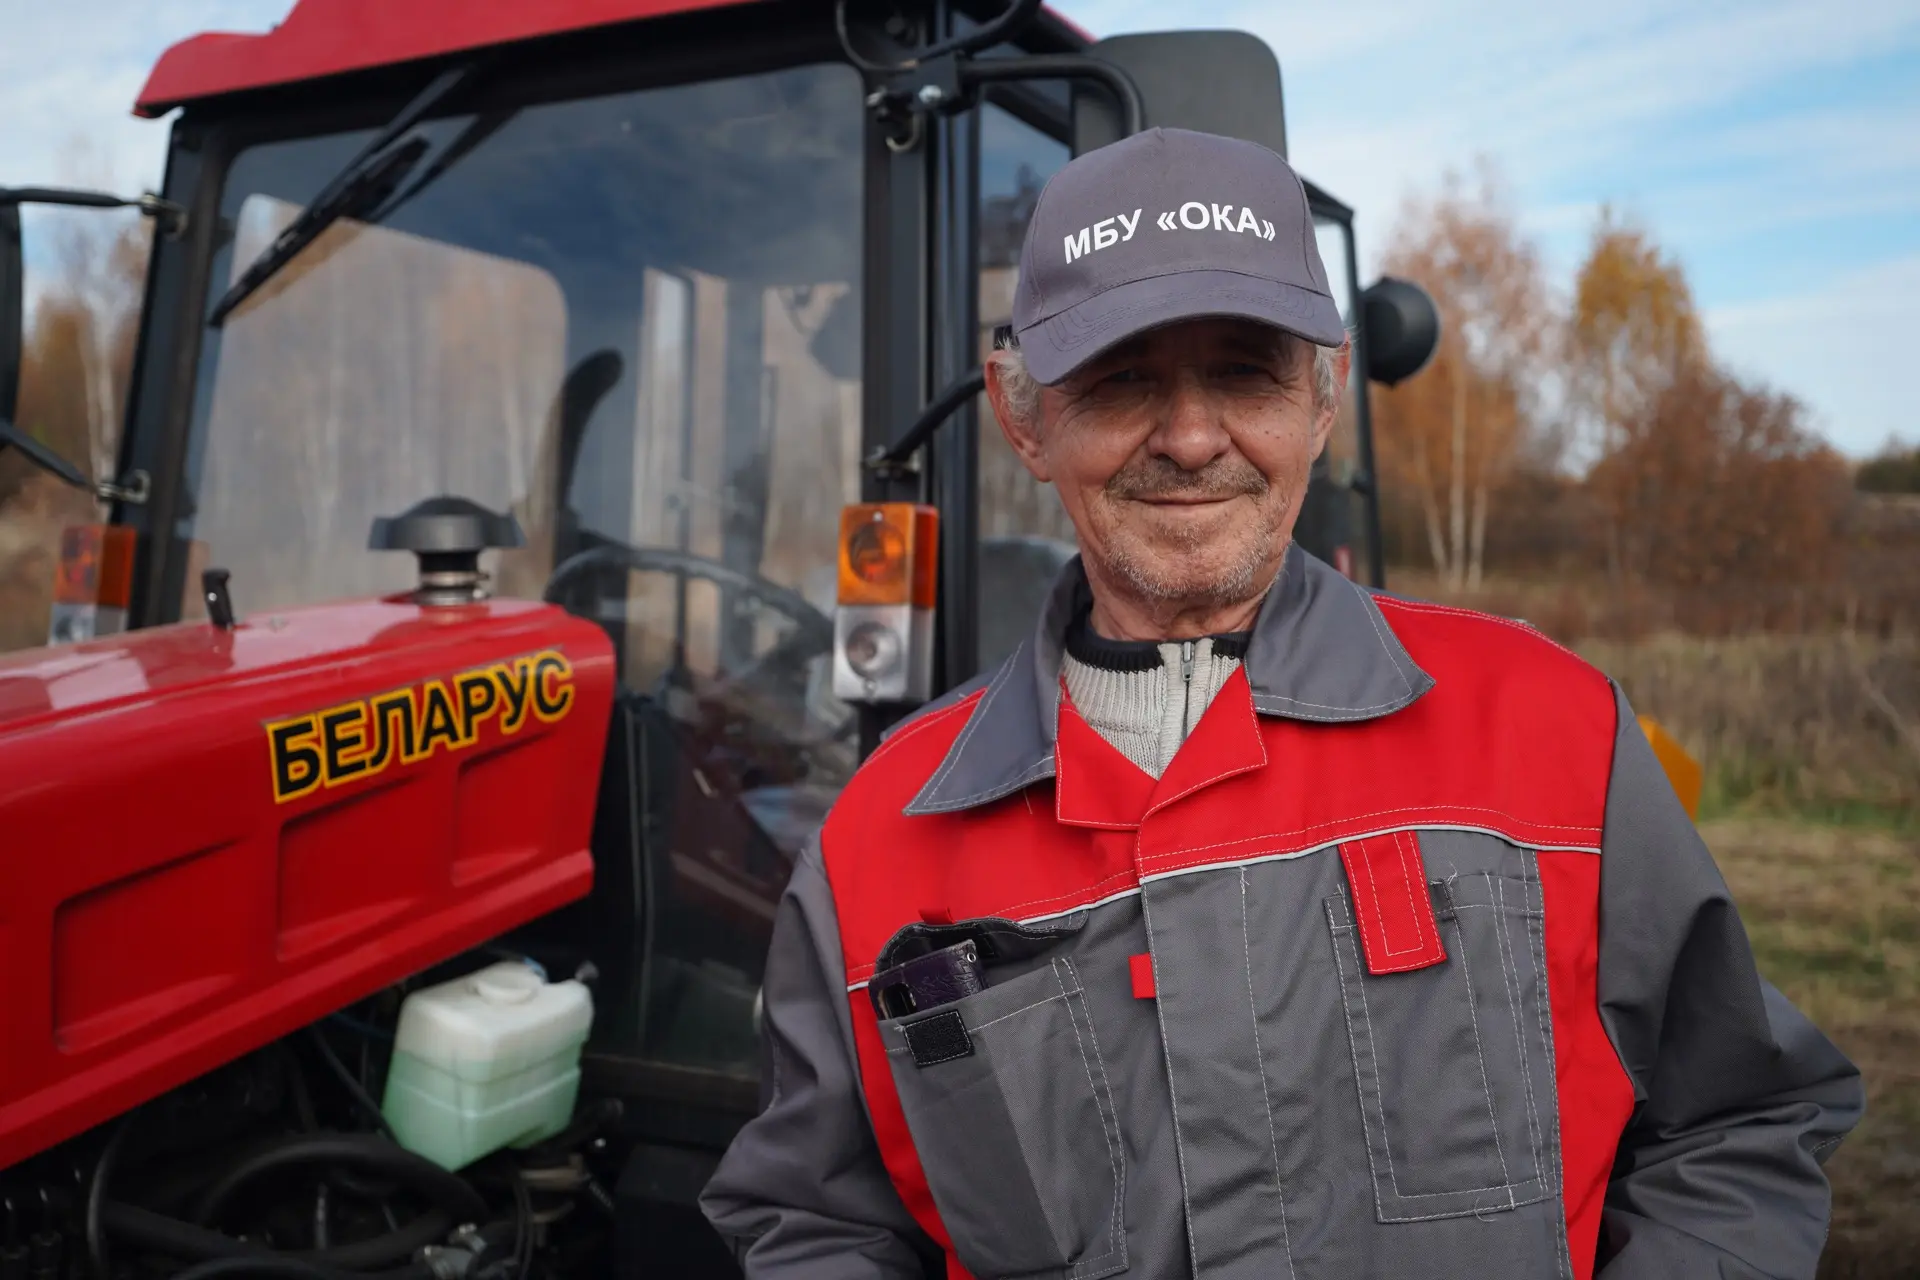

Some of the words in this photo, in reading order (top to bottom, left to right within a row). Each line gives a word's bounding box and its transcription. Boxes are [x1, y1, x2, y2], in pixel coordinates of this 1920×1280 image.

[1063, 208, 1143, 264] МБУ
[1156, 201, 1276, 242] «ОКА»
[266, 650, 575, 804] БЕЛАРУС
